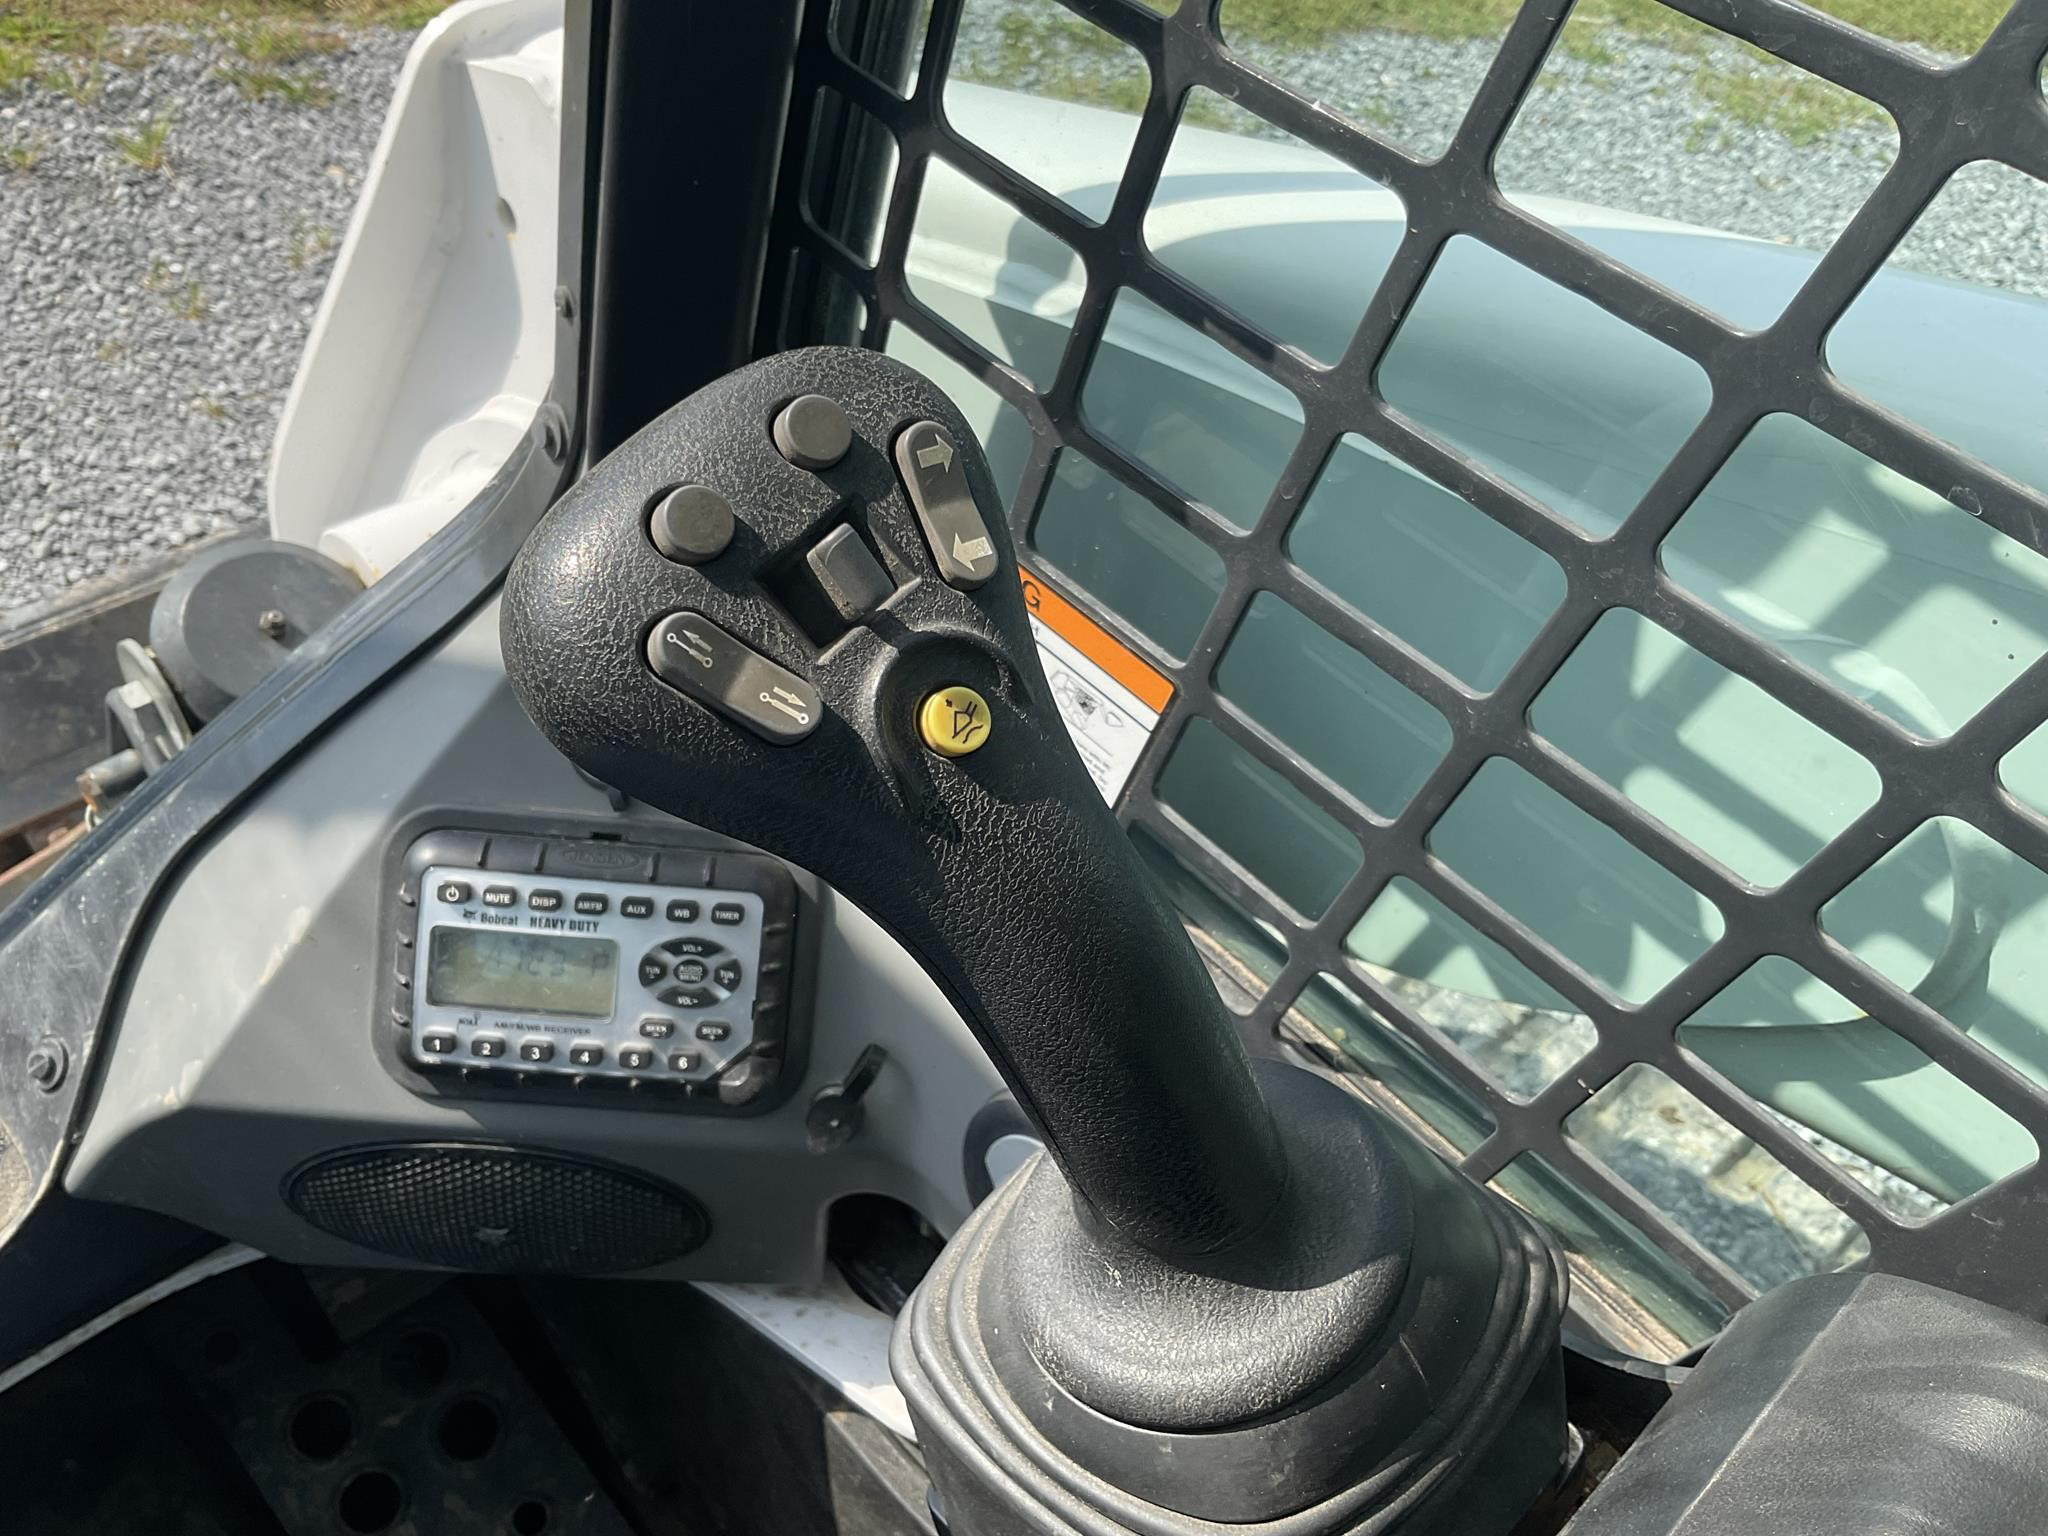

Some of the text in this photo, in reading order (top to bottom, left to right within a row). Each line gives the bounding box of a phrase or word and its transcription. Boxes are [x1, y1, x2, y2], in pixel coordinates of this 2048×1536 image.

[484, 892, 511, 904] MUTE
[531, 896, 557, 907] DISP
[626, 904, 647, 915] AUX
[673, 908, 690, 919] WB
[714, 910, 740, 921] TIMER
[479, 911, 601, 933] Bobcat HEAVY DUTY
[432, 1038, 441, 1052] 1
[481, 1042, 491, 1056] 2
[531, 1046, 540, 1060] 3
[579, 1050, 591, 1064] 4
[629, 1053, 640, 1067] 5
[678, 1056, 689, 1070] 6
